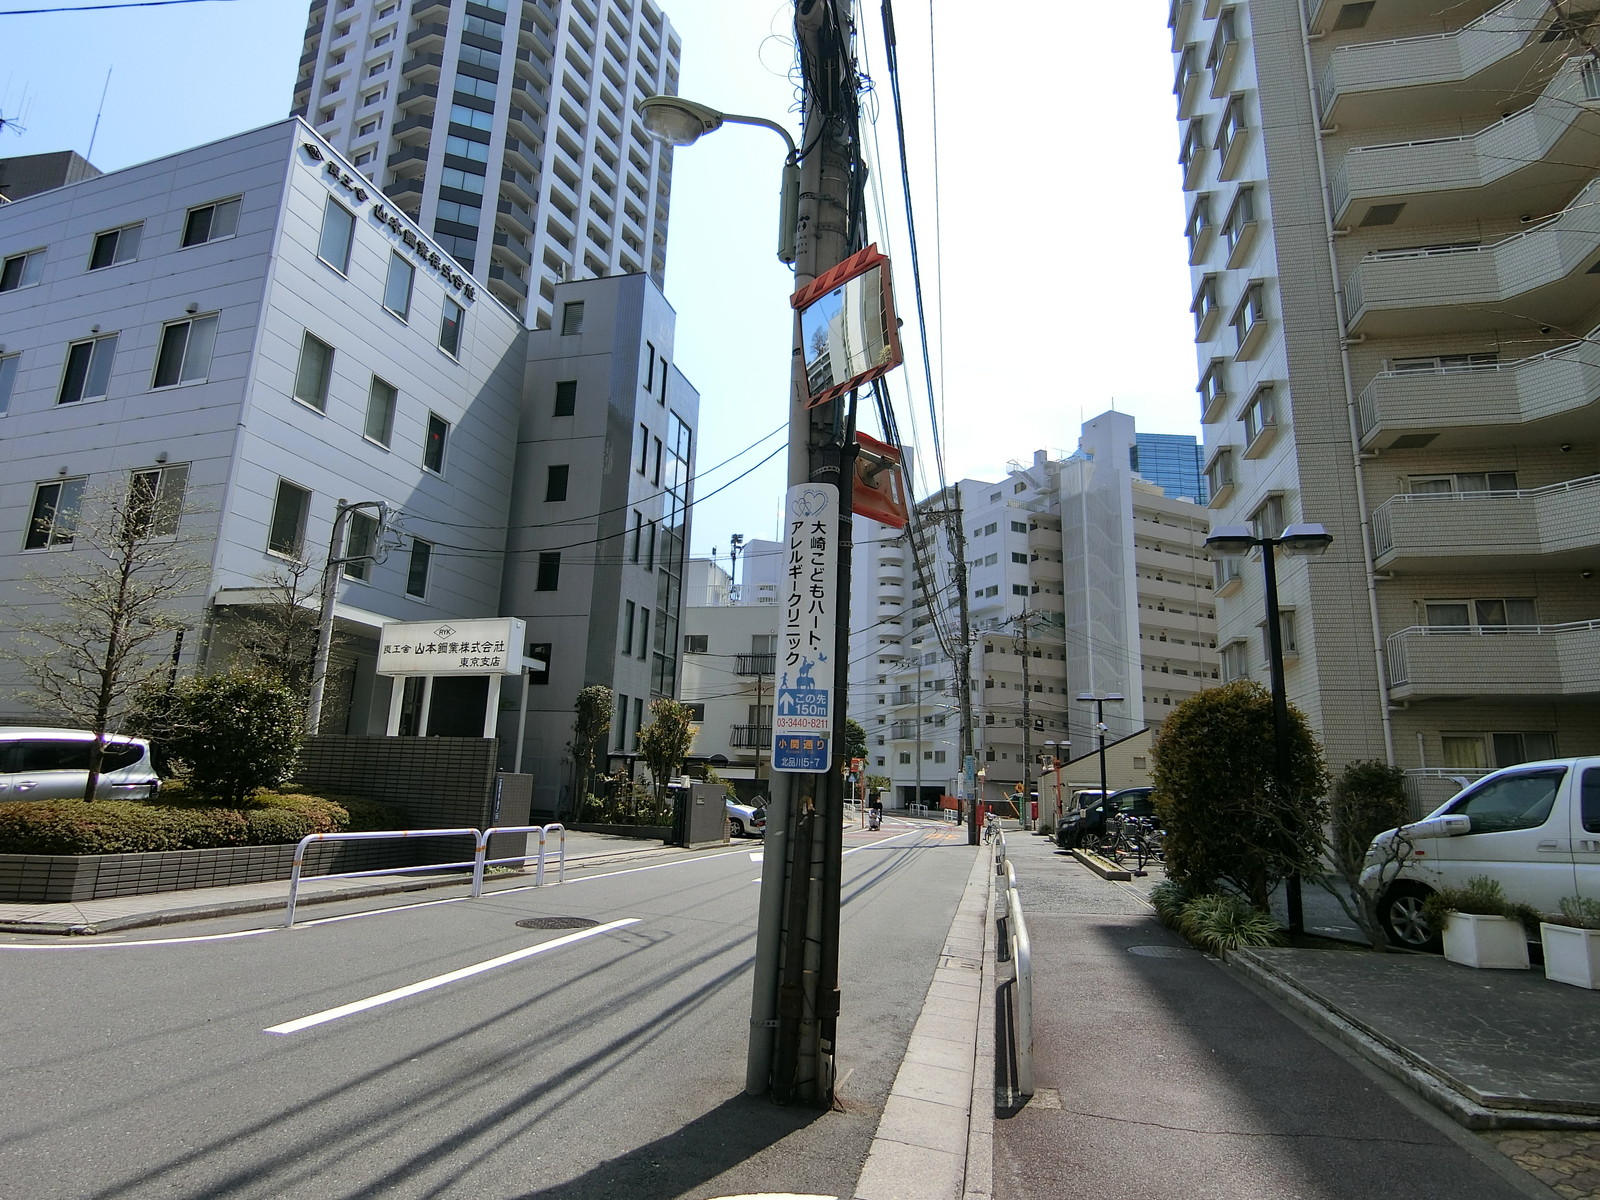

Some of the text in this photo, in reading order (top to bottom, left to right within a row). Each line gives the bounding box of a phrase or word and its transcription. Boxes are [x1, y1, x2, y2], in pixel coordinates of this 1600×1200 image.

[808, 520, 827, 651] 大崎こどもハート・
[785, 520, 804, 667] アレルギークリニック
[459, 656, 501, 668] 東京支店
[795, 693, 827, 705] この先
[795, 704, 826, 716] 150m
[776, 717, 828, 729] 03-3440-8211
[778, 738, 825, 750] 小関通り
[781, 756, 820, 768] 北品川5-7
